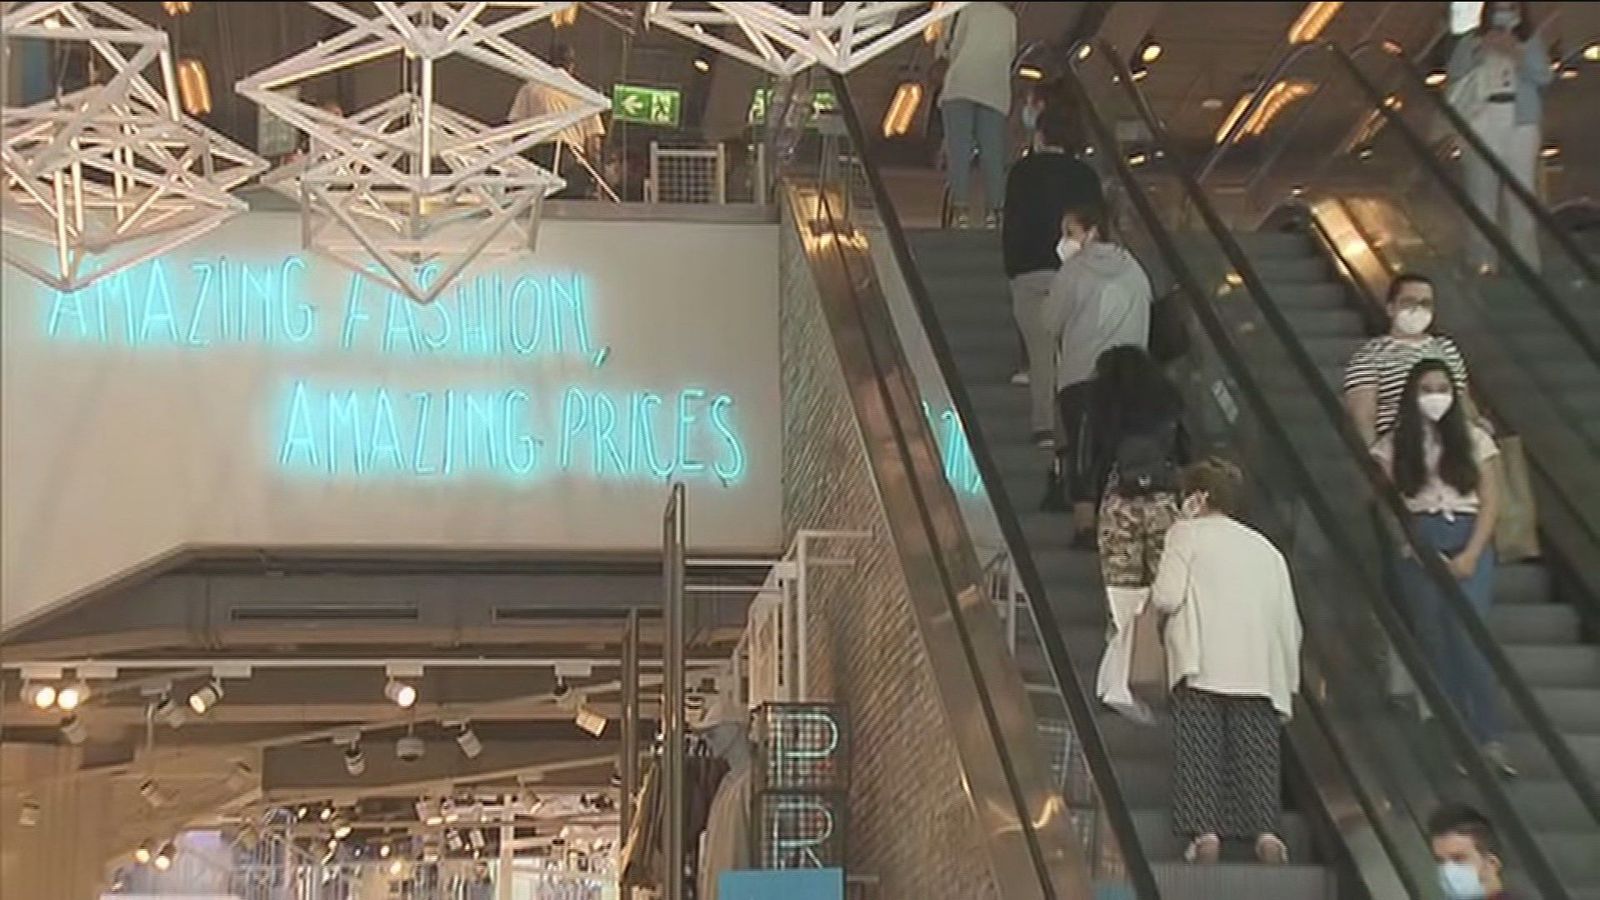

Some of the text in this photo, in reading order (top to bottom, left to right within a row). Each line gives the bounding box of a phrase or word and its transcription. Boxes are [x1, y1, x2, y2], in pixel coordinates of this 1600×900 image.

[47, 255, 313, 347] AMAZING
[279, 379, 745, 485] AMAZING PRICES
